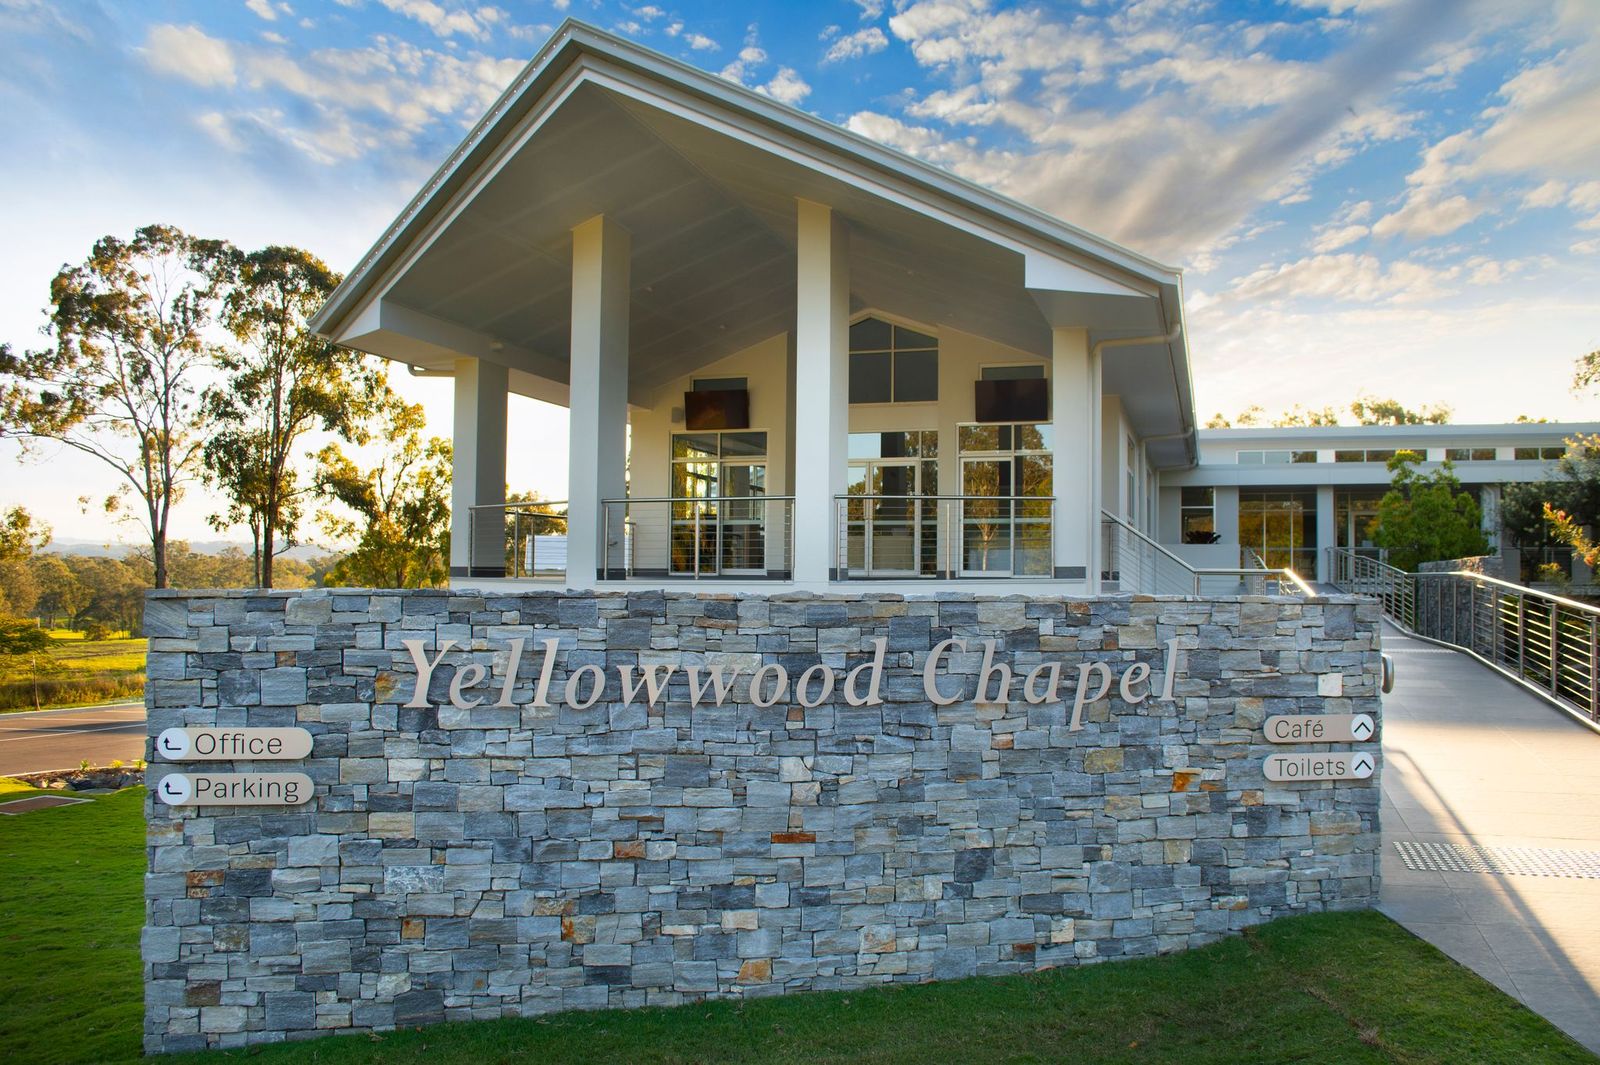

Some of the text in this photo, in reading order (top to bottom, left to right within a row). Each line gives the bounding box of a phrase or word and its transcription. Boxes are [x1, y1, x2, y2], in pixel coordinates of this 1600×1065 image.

[402, 637, 1179, 732] Yellowwood Chapel
[1275, 719, 1324, 738] Café
[195, 733, 282, 754] Office
[1274, 758, 1345, 776] Toilets
[195, 778, 299, 803] Parking
